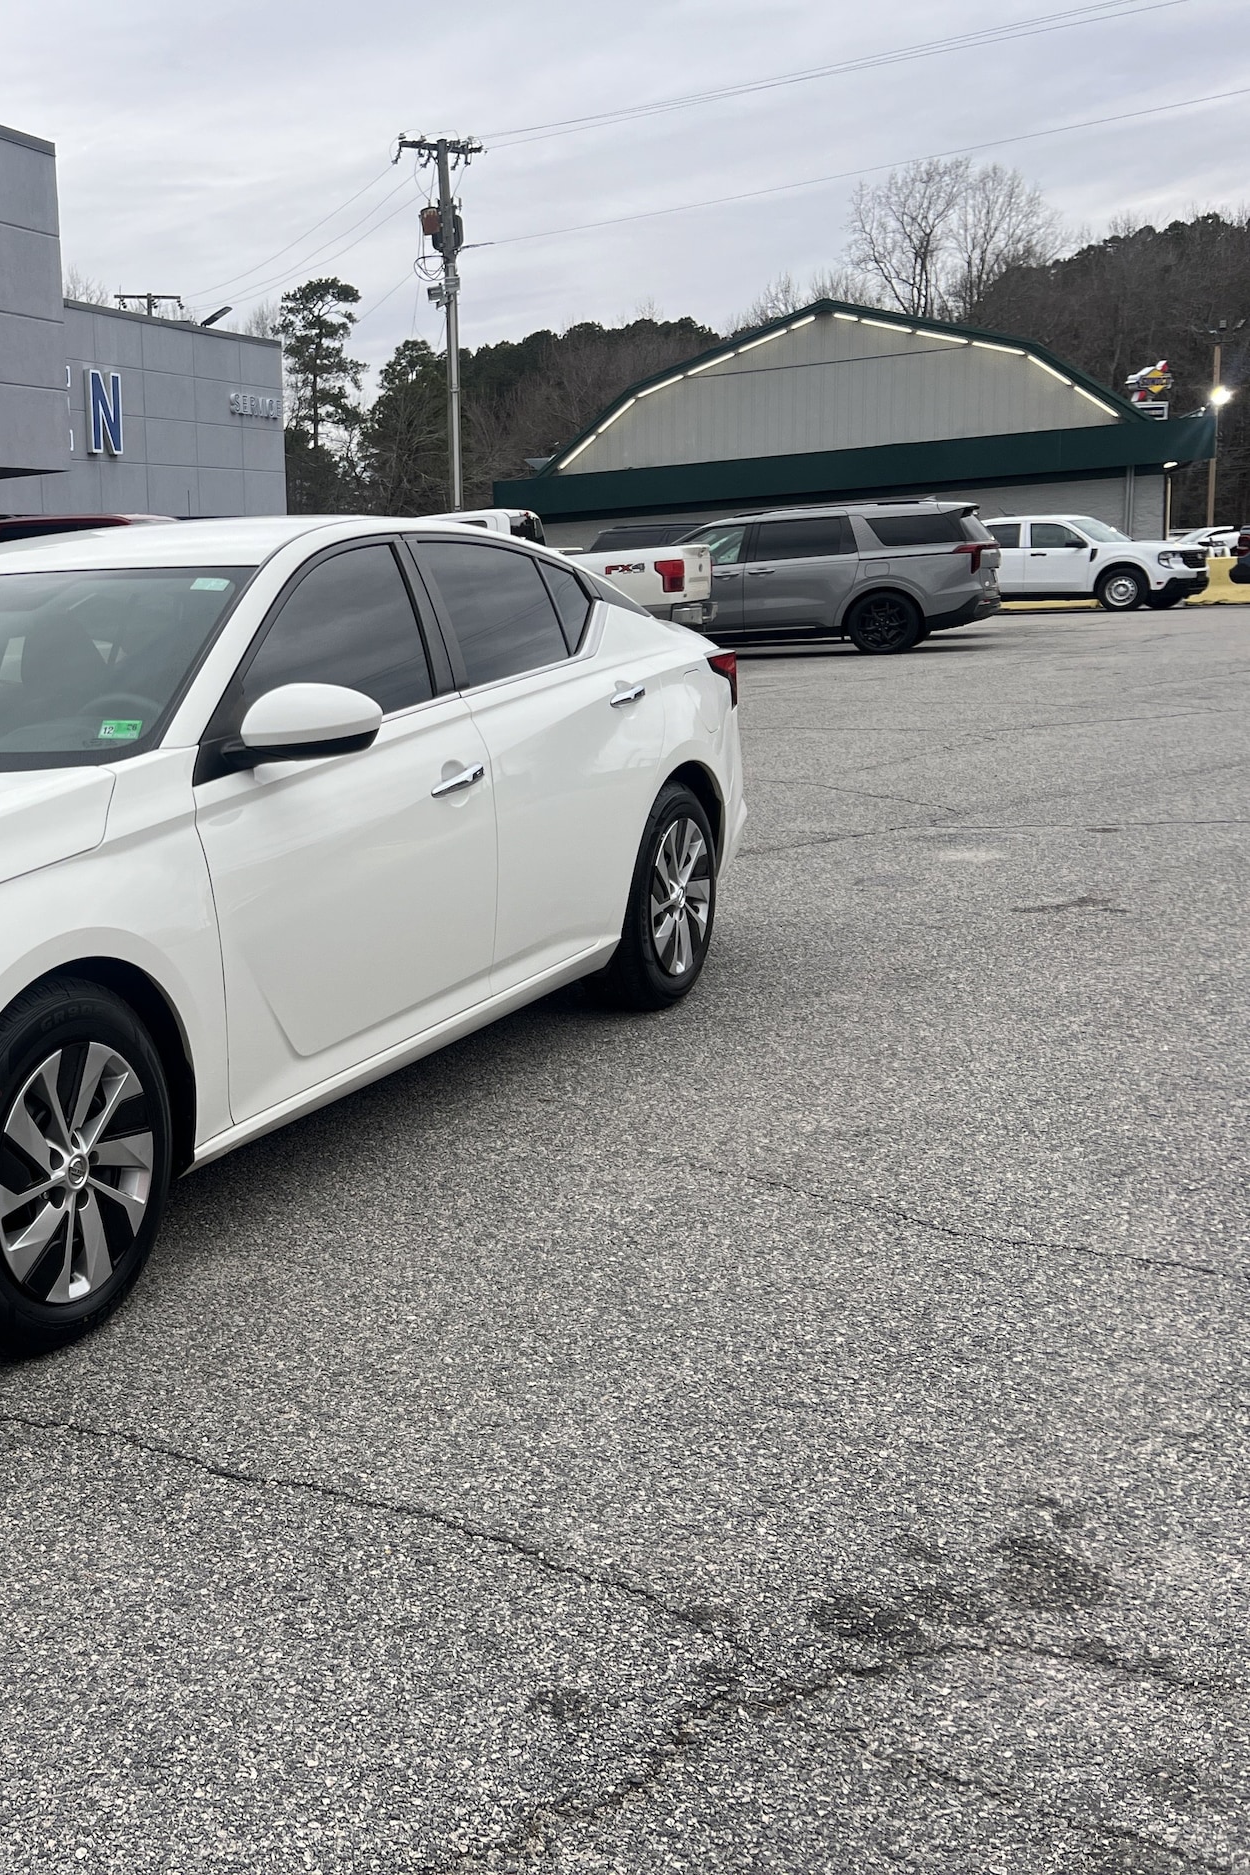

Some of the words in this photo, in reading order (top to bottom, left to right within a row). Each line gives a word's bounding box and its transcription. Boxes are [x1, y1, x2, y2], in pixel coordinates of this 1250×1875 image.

[230, 393, 282, 418] SERVICE
[605, 563, 645, 575] FX4
[103, 726, 113, 735] 12
